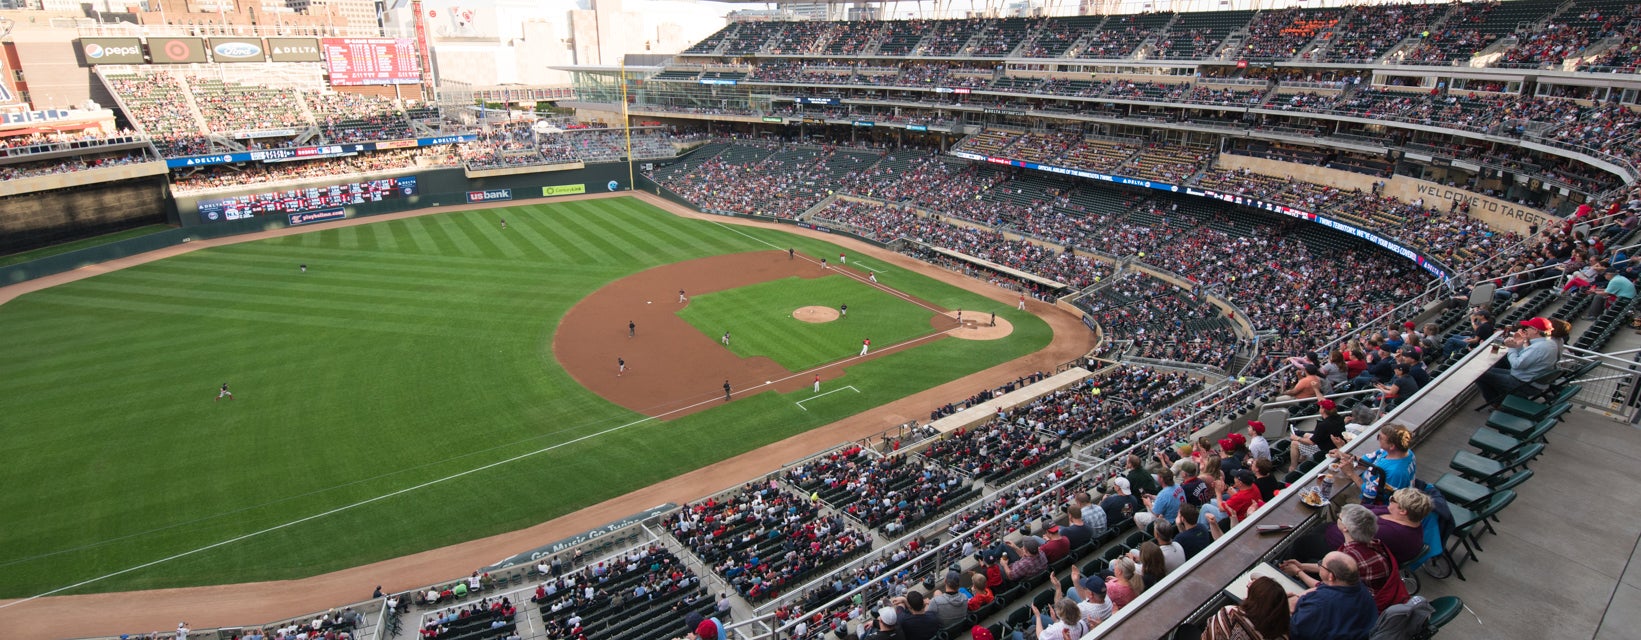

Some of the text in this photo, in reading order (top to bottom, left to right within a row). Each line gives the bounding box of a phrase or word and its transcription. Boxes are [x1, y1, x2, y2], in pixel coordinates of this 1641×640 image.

[105, 45, 139, 56] pepsi
[223, 46, 252, 56] Ford
[283, 46, 317, 54] DELTA
[11, 109, 70, 122] FIELD
[437, 136, 456, 144] DELTA
[194, 156, 221, 164] DELTA
[1127, 178, 1144, 186] DELTA
[1417, 183, 1546, 225] WELCOME TO TARGET
[1319, 216, 1333, 227] TWINS
[589, 530, 606, 539] Go
